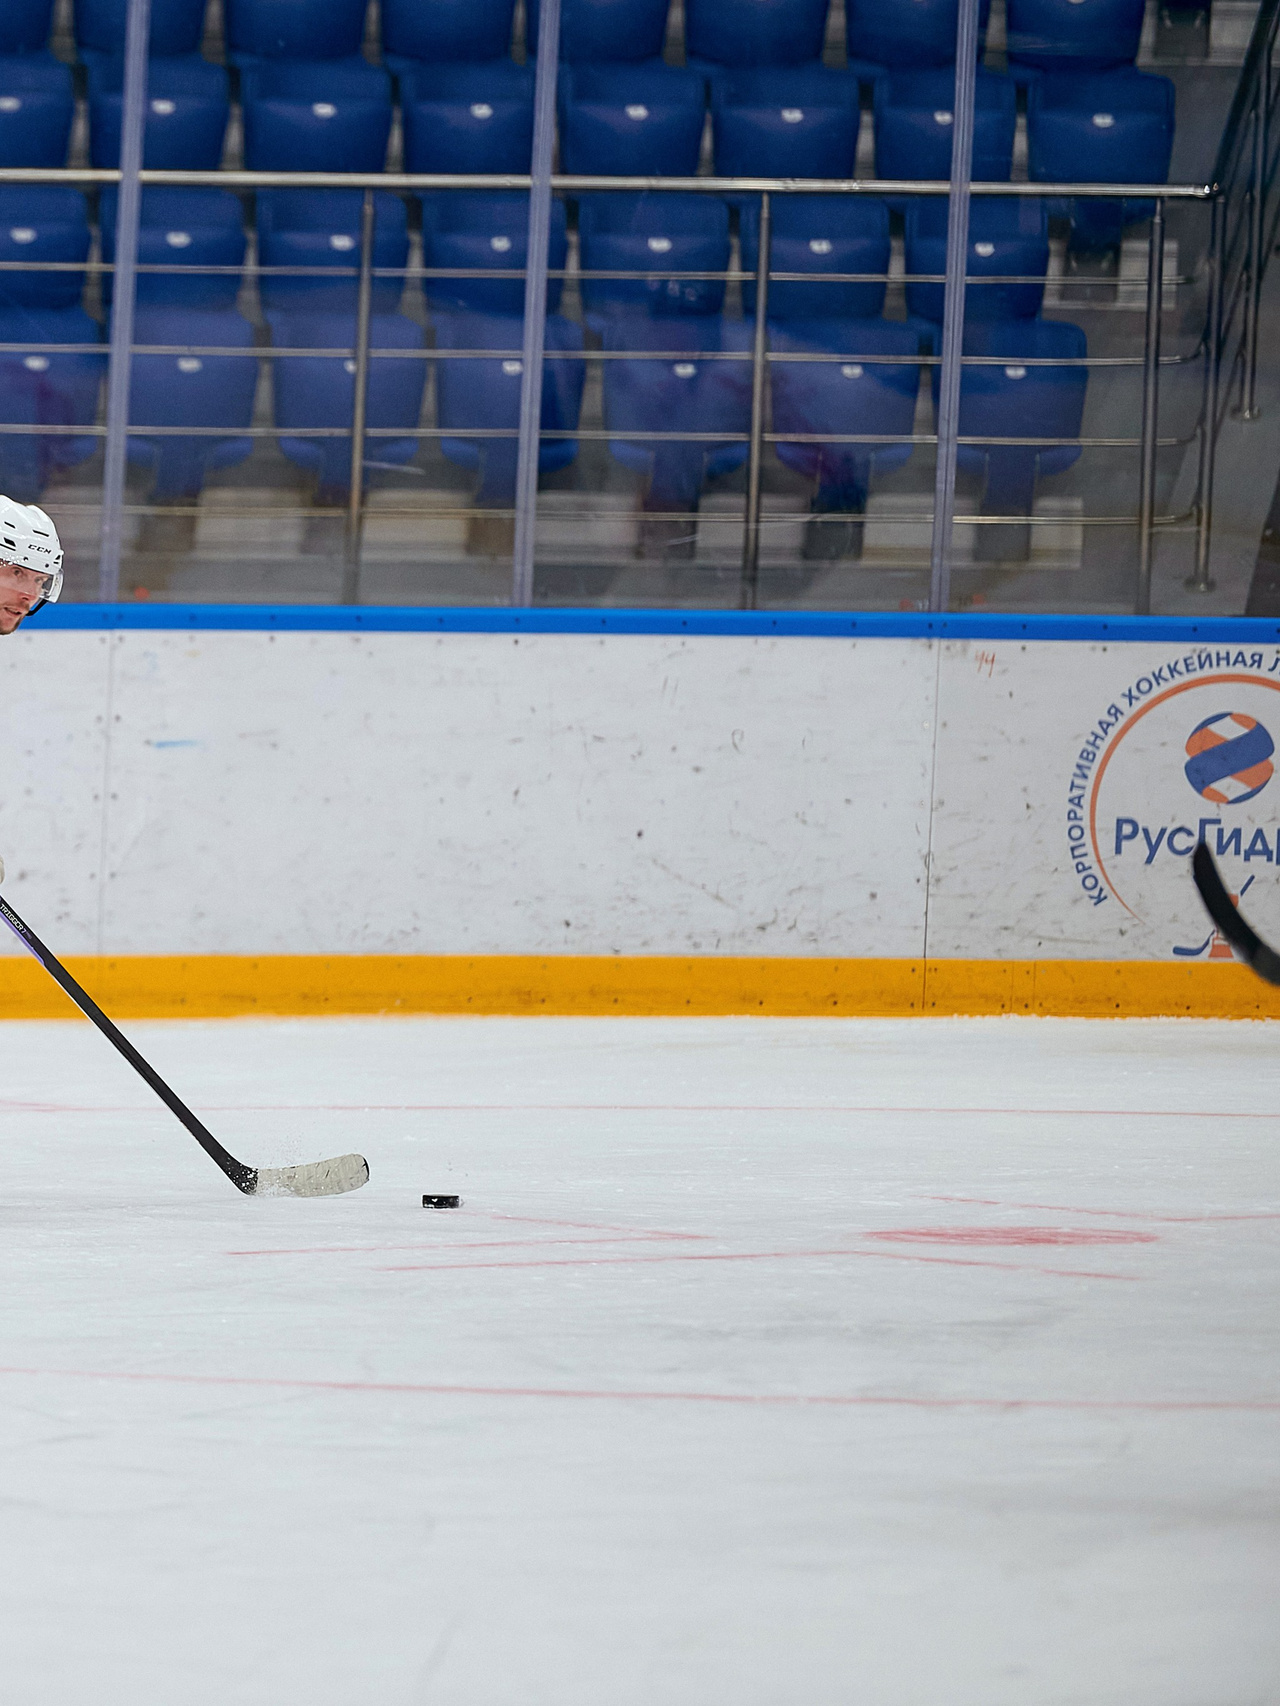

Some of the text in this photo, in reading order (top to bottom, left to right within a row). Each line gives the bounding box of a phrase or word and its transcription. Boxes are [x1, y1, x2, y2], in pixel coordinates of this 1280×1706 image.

[27, 544, 52, 555] CCM
[1067, 703, 1124, 906] КОРПОРАТИВНАЯ
[1121, 647, 1263, 708] ХОККЕЙНАЯ
[1114, 817, 1280, 866] РусГид
